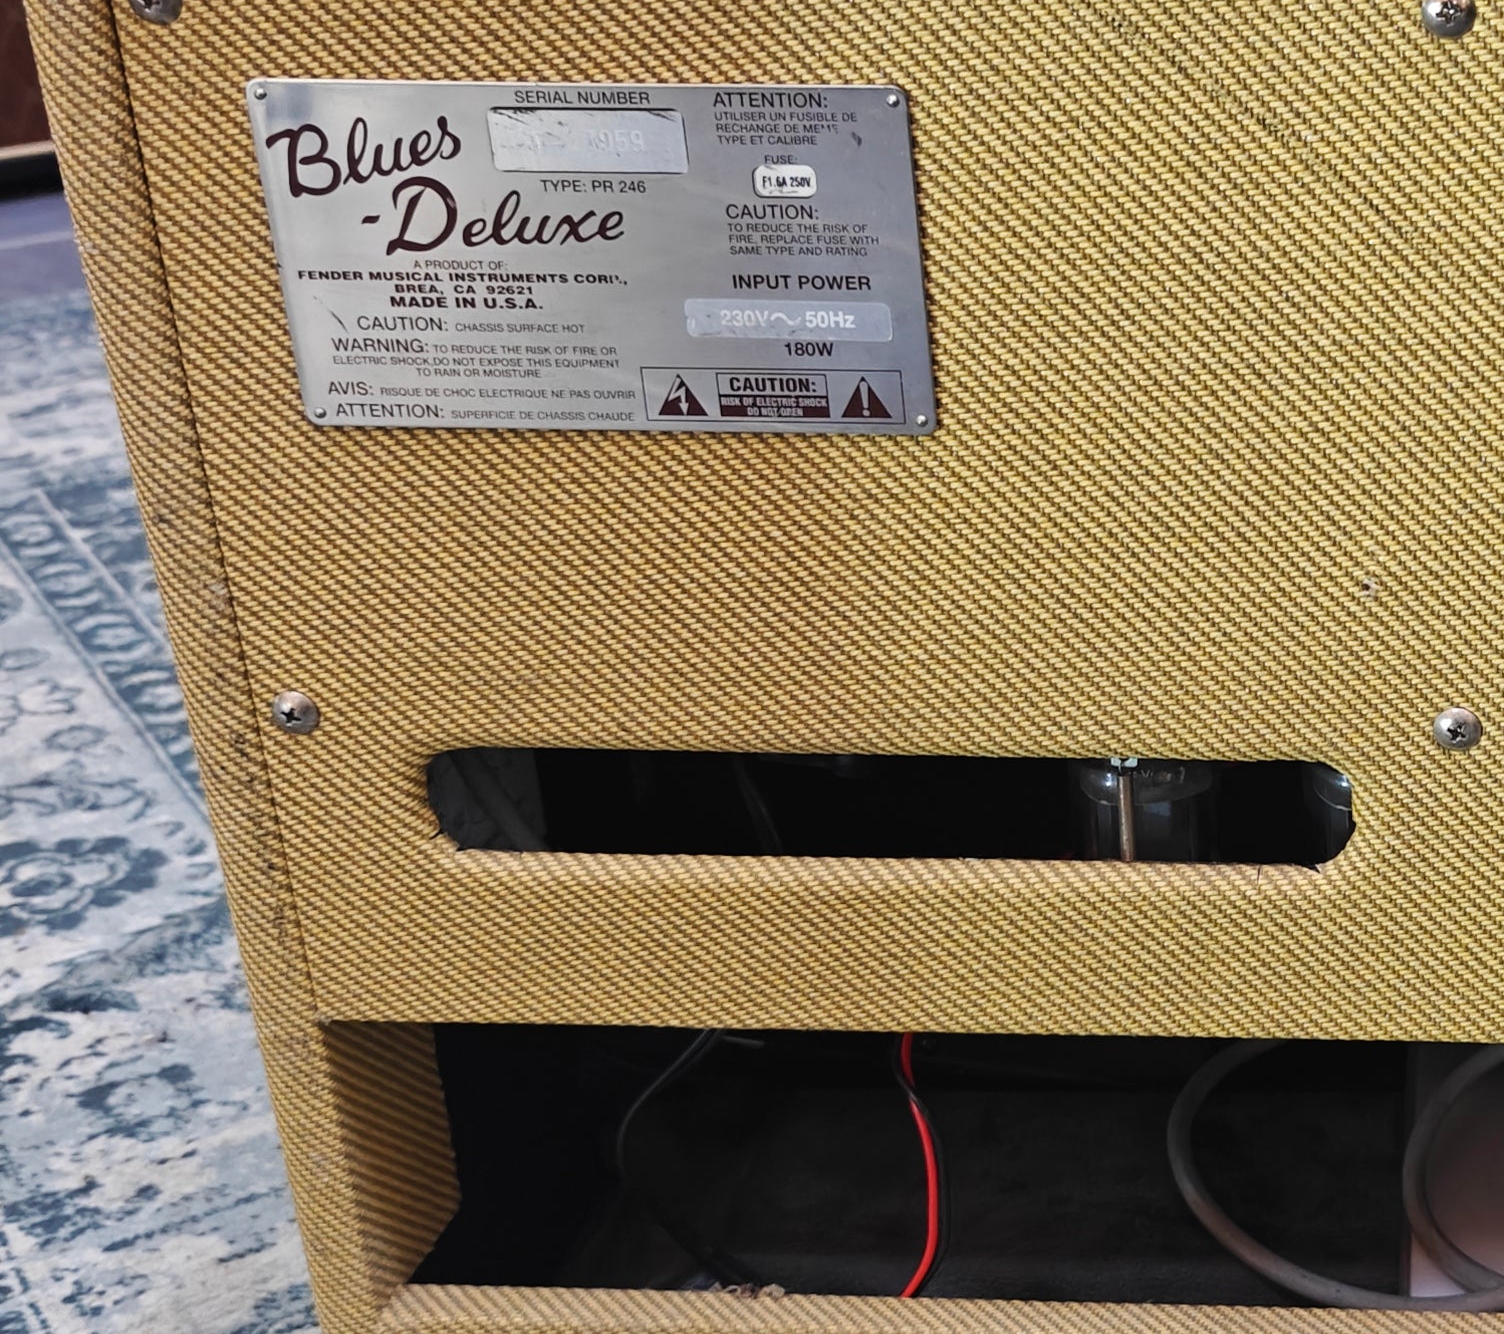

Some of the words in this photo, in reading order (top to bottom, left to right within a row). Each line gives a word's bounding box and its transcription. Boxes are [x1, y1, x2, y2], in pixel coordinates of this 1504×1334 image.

[515, 90, 573, 104] SERIAL
[577, 91, 650, 105] NUMBER
[713, 92, 828, 108] ATTENTION:
[714, 112, 766, 122] UTILISER
[770, 112, 786, 122] UN
[790, 112, 838, 122] FUSIBLE
[842, 112, 857, 122] DE
[716, 123, 780, 133] RECHANGE
[784, 124, 800, 133] DE
[717, 135, 746, 145] TYPE
[751, 135, 763, 145] ET
[768, 135, 817, 146] CALIBRE
[266, 116, 461, 198] Blues
[540, 180, 587, 193] TYPE:
[592, 180, 614, 193] PR
[619, 181, 646, 193] 246
[790, 177, 811, 187] 250V
[726, 204, 819, 220] CAUTION:
[728, 223, 743, 232] TO
[746, 223, 793, 233] REDUCE
[797, 223, 819, 233] THE
[823, 224, 849, 233] RISK
[853, 224, 868, 233] OF
[760, 235, 813, 244] REPLACE
[817, 235, 846, 245] FUSE
[849, 236, 879, 245] WITH
[730, 246, 762, 255] SAME
[765, 246, 795, 256] TYPE
[799, 246, 822, 256] AND
[826, 247, 867, 257] RATING
[413, 260, 422, 269] A
[425, 260, 483, 270] PRODUCT
[297, 270, 363, 281] FENDER
[369, 271, 443, 282] MUSICAL
[449, 272, 569, 283] INSTRUMENTS
[732, 274, 791, 289] INPUT
[798, 275, 871, 290] POWER
[454, 285, 476, 294] CA
[486, 285, 533, 295] 92621
[390, 296, 448, 308] MADE
[455, 297, 476, 309] IN
[484, 297, 543, 309] U.S.A.
[357, 315, 448, 332] CAUTION:
[455, 323, 504, 333] CHASSIS
[507, 323, 558, 333] SURFACE
[562, 324, 585, 334] HOT
[805, 310, 856, 329] 50Hz
[331, 338, 429, 353] WARNING:
[433, 344, 448, 354] TO
[452, 345, 497, 354] REDUCE
[501, 345, 522, 355] THE
[526, 346, 551, 355] RISK
[555, 346, 568, 355] OF
[573, 346, 598, 356] FIRE
[601, 346, 617, 356] OR
[784, 342, 833, 357] 180W
[333, 356, 387, 365] ELECTRIC
[453, 358, 475, 367] NOT
[480, 358, 523, 367] EXPOSE
[526, 358, 552, 368] THIS
[555, 359, 619, 368] EQUIPMENT
[416, 368, 431, 377] TO
[434, 368, 461, 377] RAIN
[464, 368, 480, 377] OR
[483, 369, 542, 378] MOISTURE
[328, 381, 374, 396] AVIS:
[380, 387, 421, 397] RISQUE
[426, 388, 440, 397] DE
[443, 388, 476, 398] CHOC
[480, 389, 548, 398] ELECTRIQUE
[552, 390, 566, 398] NE
[569, 390, 590, 399] PAS
[594, 390, 636, 399] OUVRIR
[730, 376, 816, 393] CAUTION:
[721, 396, 741, 406] RISK
[743, 396, 755, 406] OF
[757, 396, 797, 407] ELECTRIC
[799, 397, 828, 407] SHOCK
[336, 403, 445, 418] ATTENTION:
[451, 410, 515, 420] SUPERFICIE
[519, 411, 534, 420] DE
[538, 411, 585, 421] CHASSIS
[589, 412, 635, 421] CHAUDE
[747, 407, 759, 416] DO
